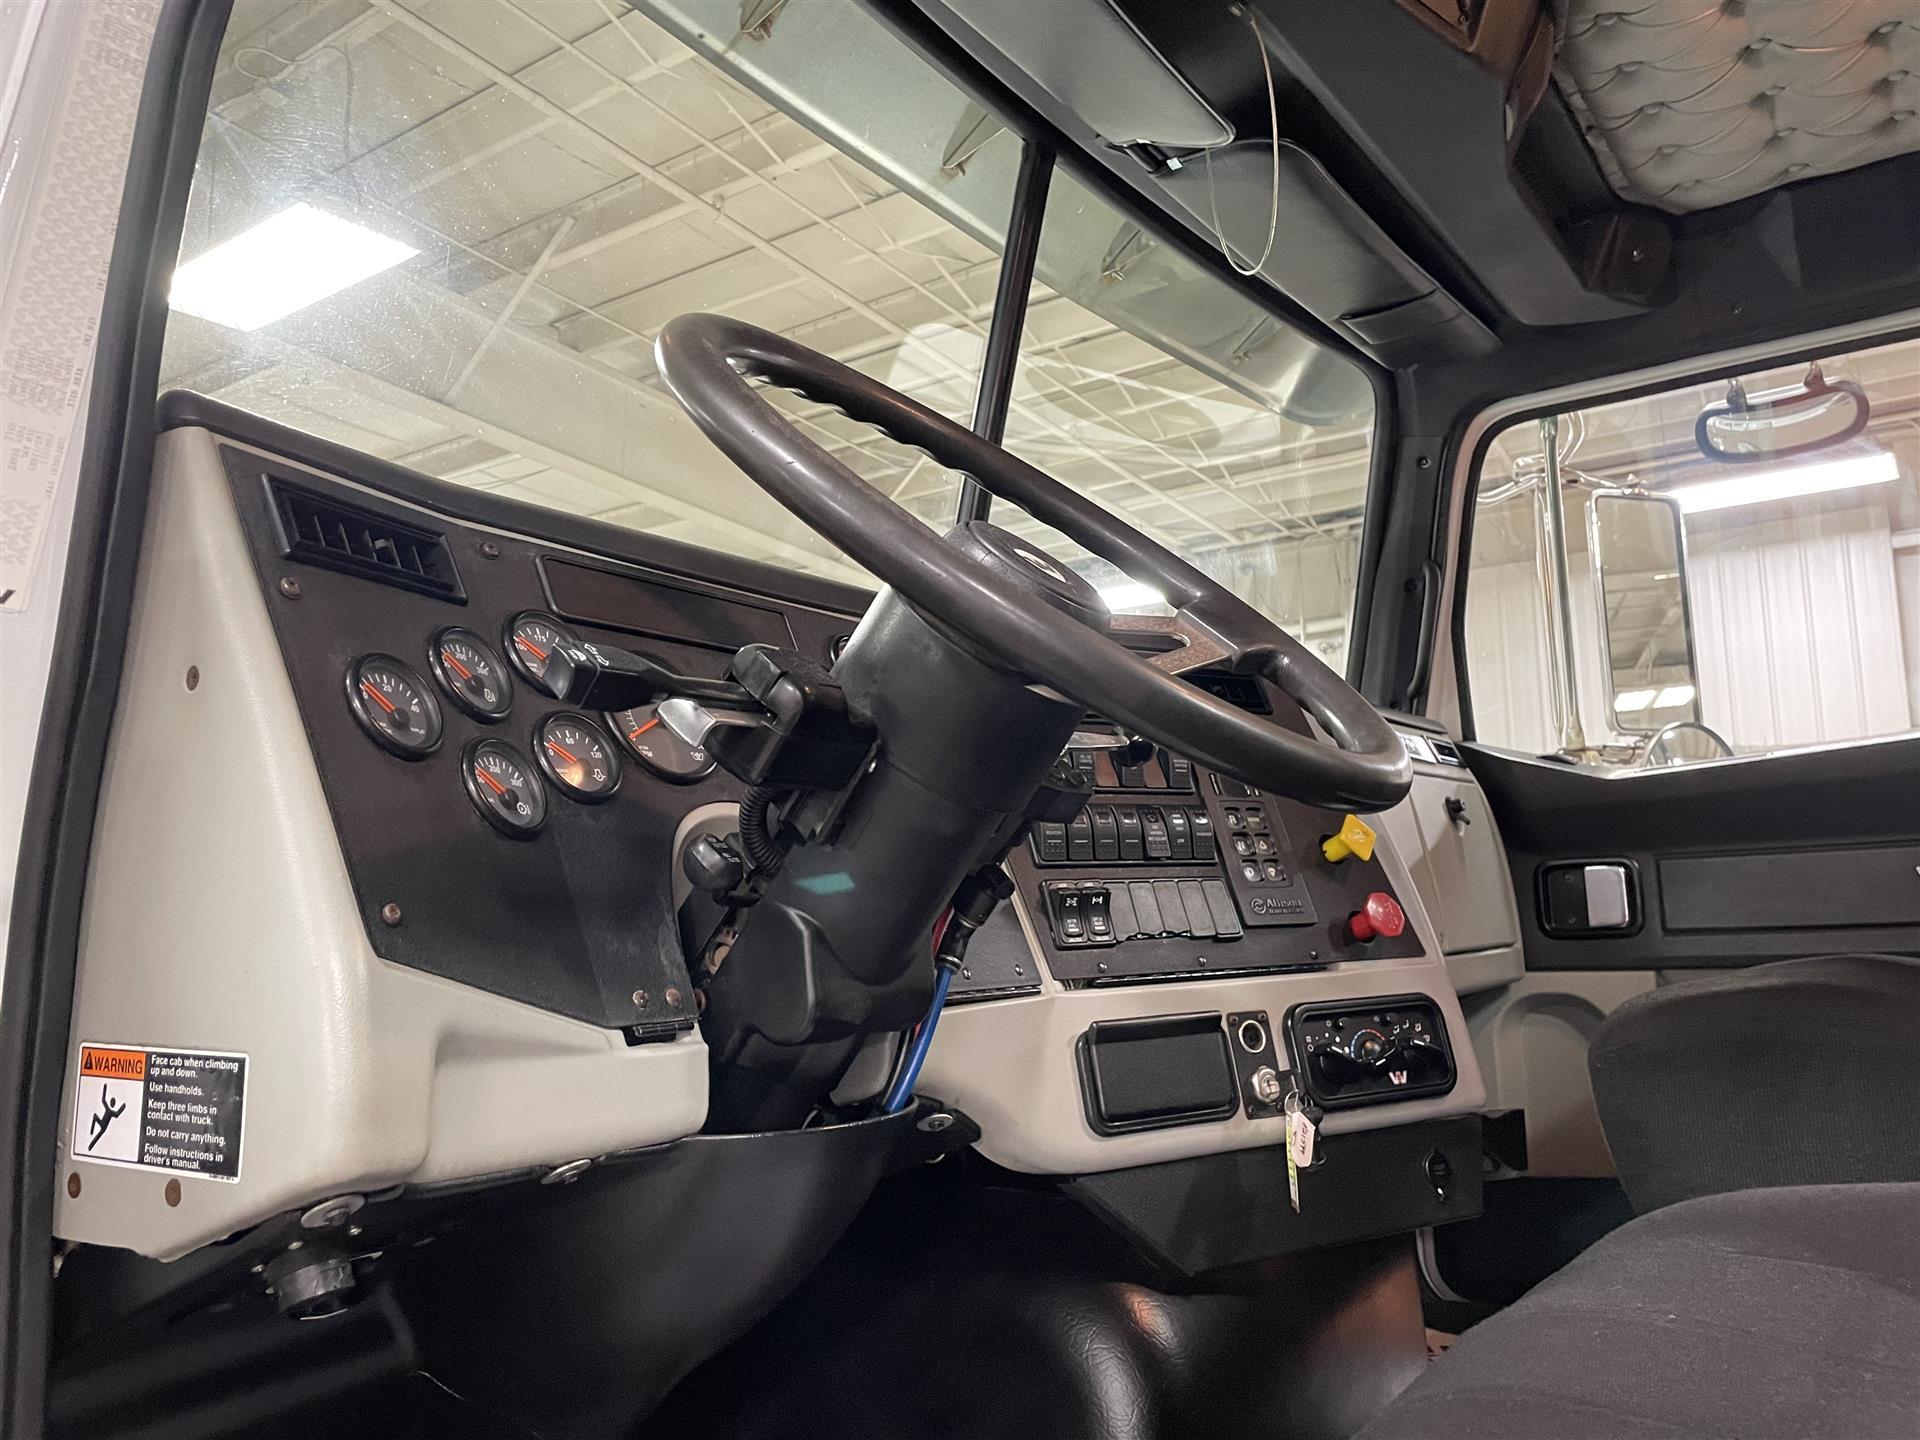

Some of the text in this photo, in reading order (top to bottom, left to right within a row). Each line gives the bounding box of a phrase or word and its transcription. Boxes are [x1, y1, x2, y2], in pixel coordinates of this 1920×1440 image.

[382, 683, 392, 692] 20
[362, 690, 369, 699] 0
[565, 737, 575, 745] 60
[548, 748, 554, 756] 0
[590, 751, 602, 759] 120
[1228, 814, 1238, 824] R
[1266, 898, 1303, 908] Allison
[94, 1056, 143, 1074] WARNING
[151, 1054, 238, 1072] Face cab when climbing
[150, 1067, 198, 1078] up and down.
[149, 1082, 204, 1096] Use handholds.
[148, 1099, 217, 1114] Keep three limbs in
[147, 1108, 213, 1125] contact with truck.
[146, 1126, 226, 1147] Do not carry anything.
[144, 1143, 223, 1162] Follow instructions in
[143, 1153, 200, 1169] driver's manual.
